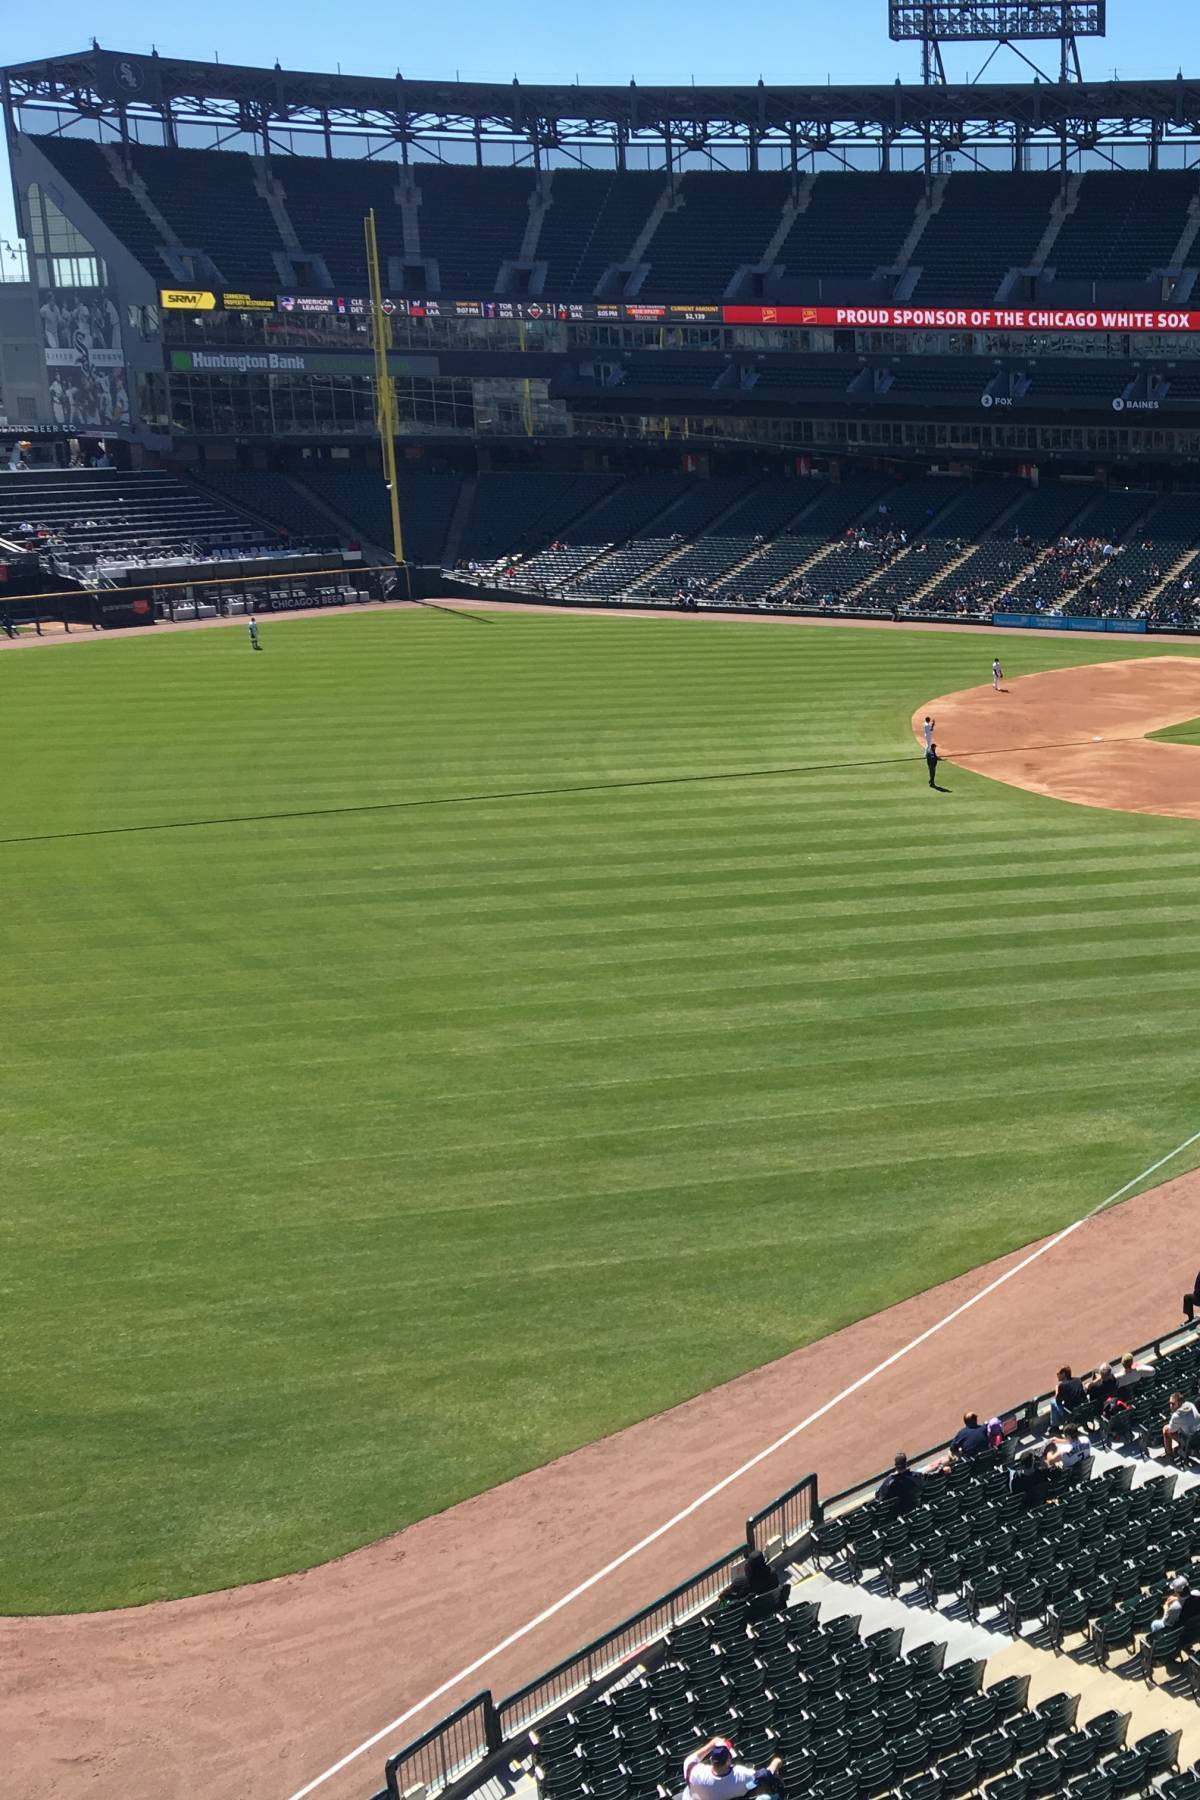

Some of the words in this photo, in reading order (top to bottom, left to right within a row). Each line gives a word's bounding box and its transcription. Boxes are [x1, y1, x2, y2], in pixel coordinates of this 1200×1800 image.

[168, 295, 197, 303] SRM
[837, 310, 889, 323] PROUD
[893, 310, 967, 325] SPONSOR
[971, 312, 991, 325] OF
[995, 312, 1023, 326] THE
[1028, 312, 1097, 327] CHICAGO
[1101, 313, 1153, 327] WHITE
[1158, 313, 1190, 328] SOX
[192, 352, 268, 372] Huntington
[269, 353, 305, 370] Bank
[995, 397, 1013, 406] FOX
[1126, 400, 1160, 409] BAINES
[34, 424, 59, 433] BEER
[271, 597, 320, 609] CHICAGO'S
[322, 596, 343, 606] BEER
